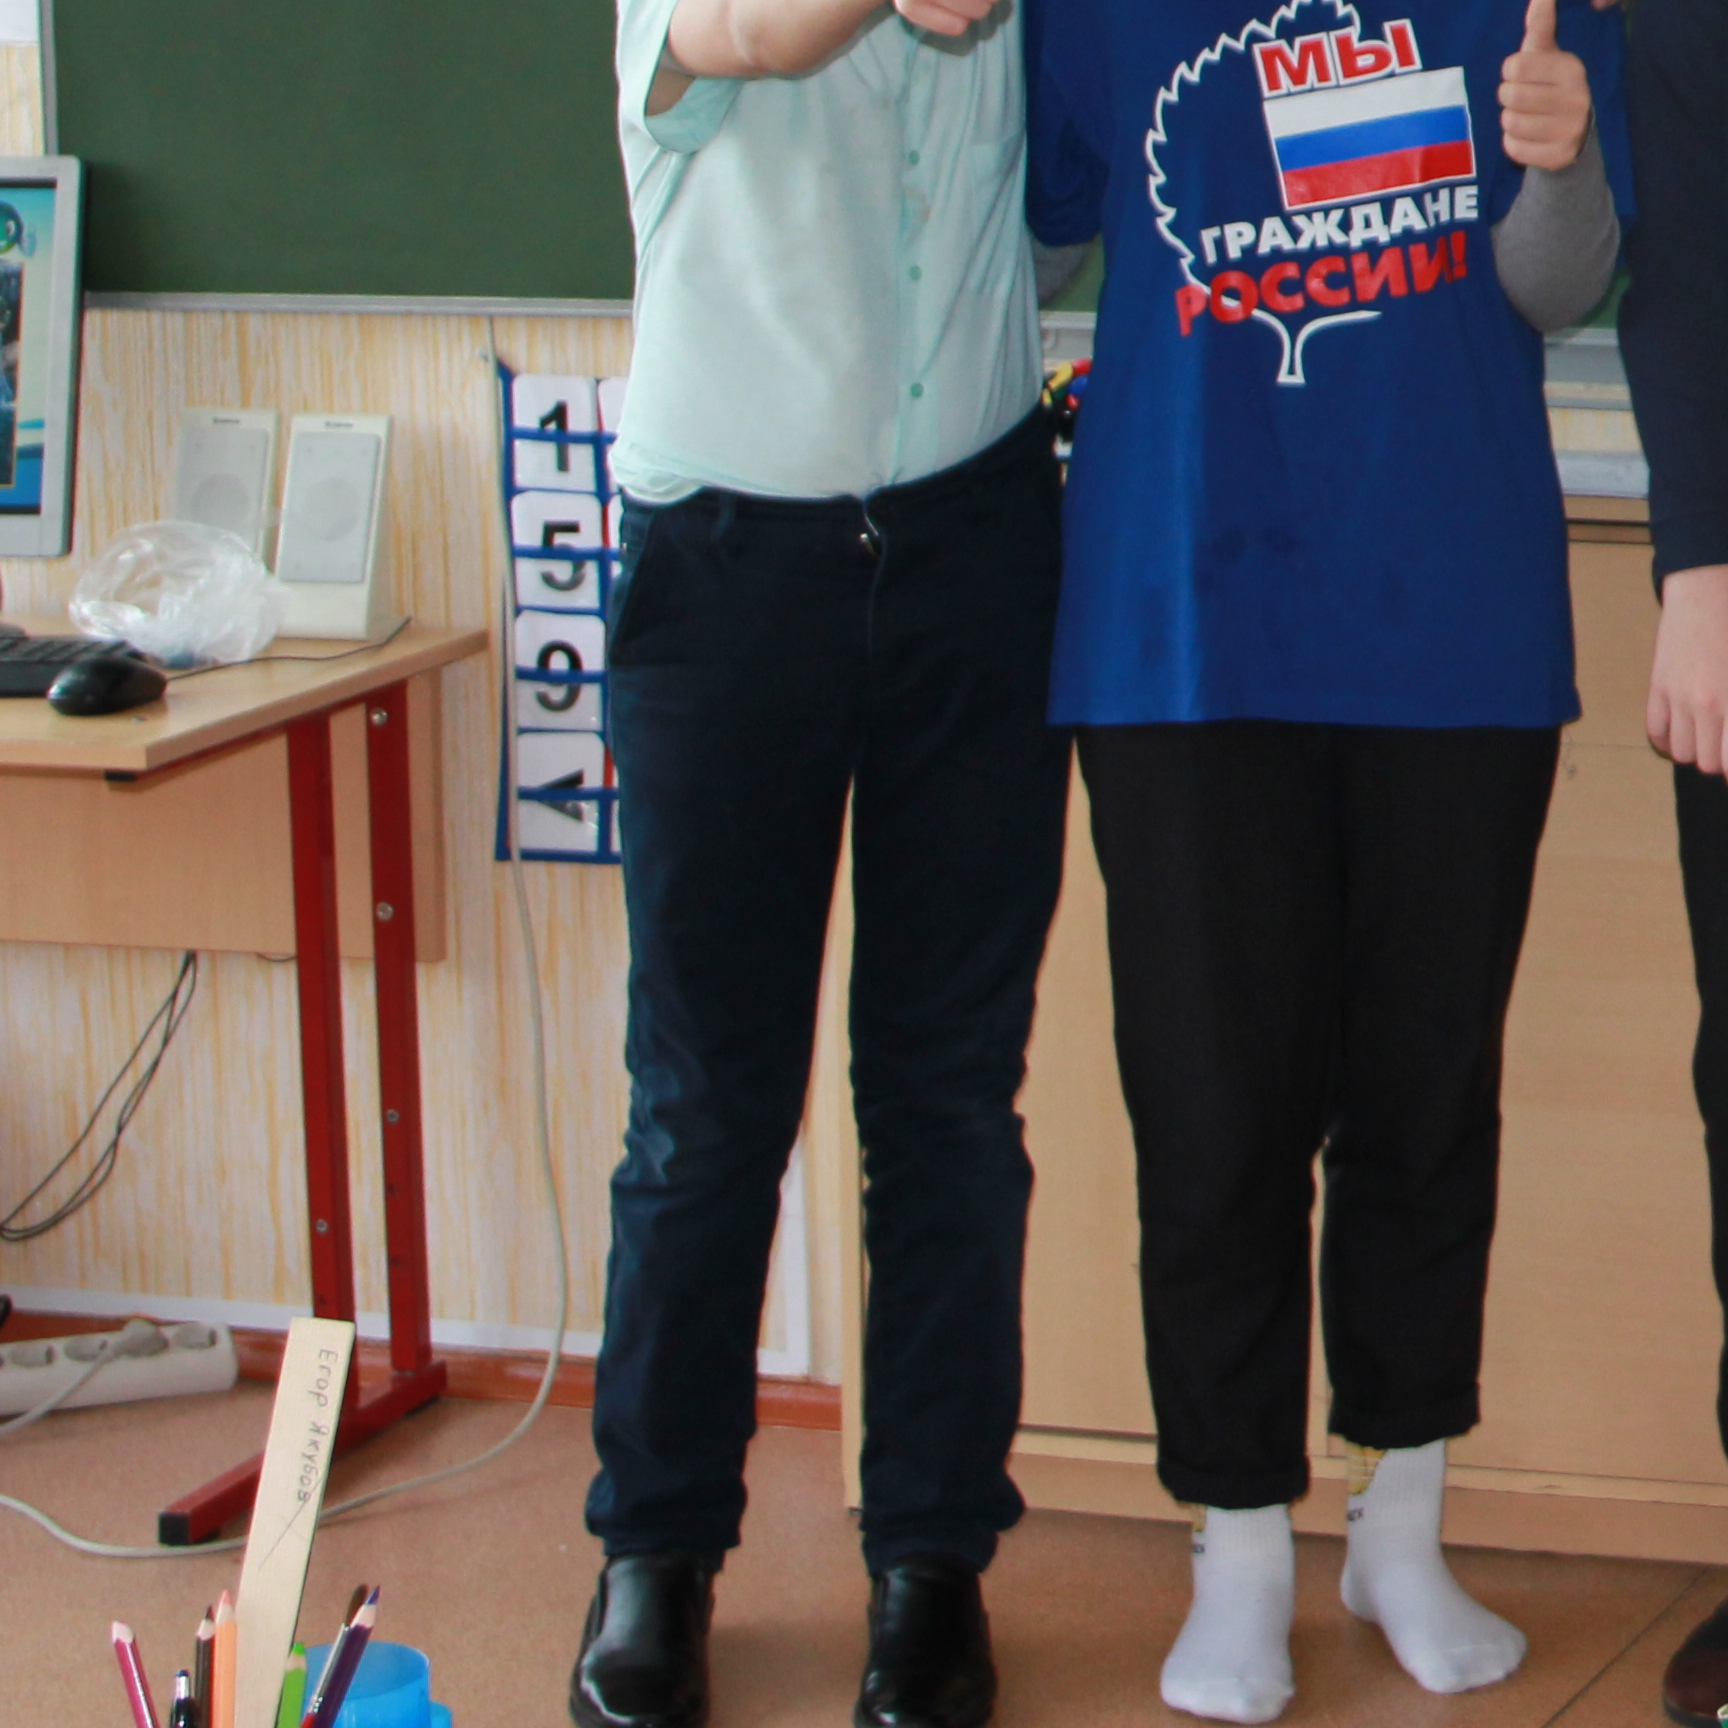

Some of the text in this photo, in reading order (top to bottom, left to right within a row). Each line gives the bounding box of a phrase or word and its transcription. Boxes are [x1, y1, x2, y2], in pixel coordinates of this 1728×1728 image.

[1253, 19, 1422, 98] МЫ
[1200, 185, 1478, 265] ГРАЖДАНЕ
[1175, 231, 1468, 337] РОССИИ!
[309, 1349, 338, 1407] Егор
